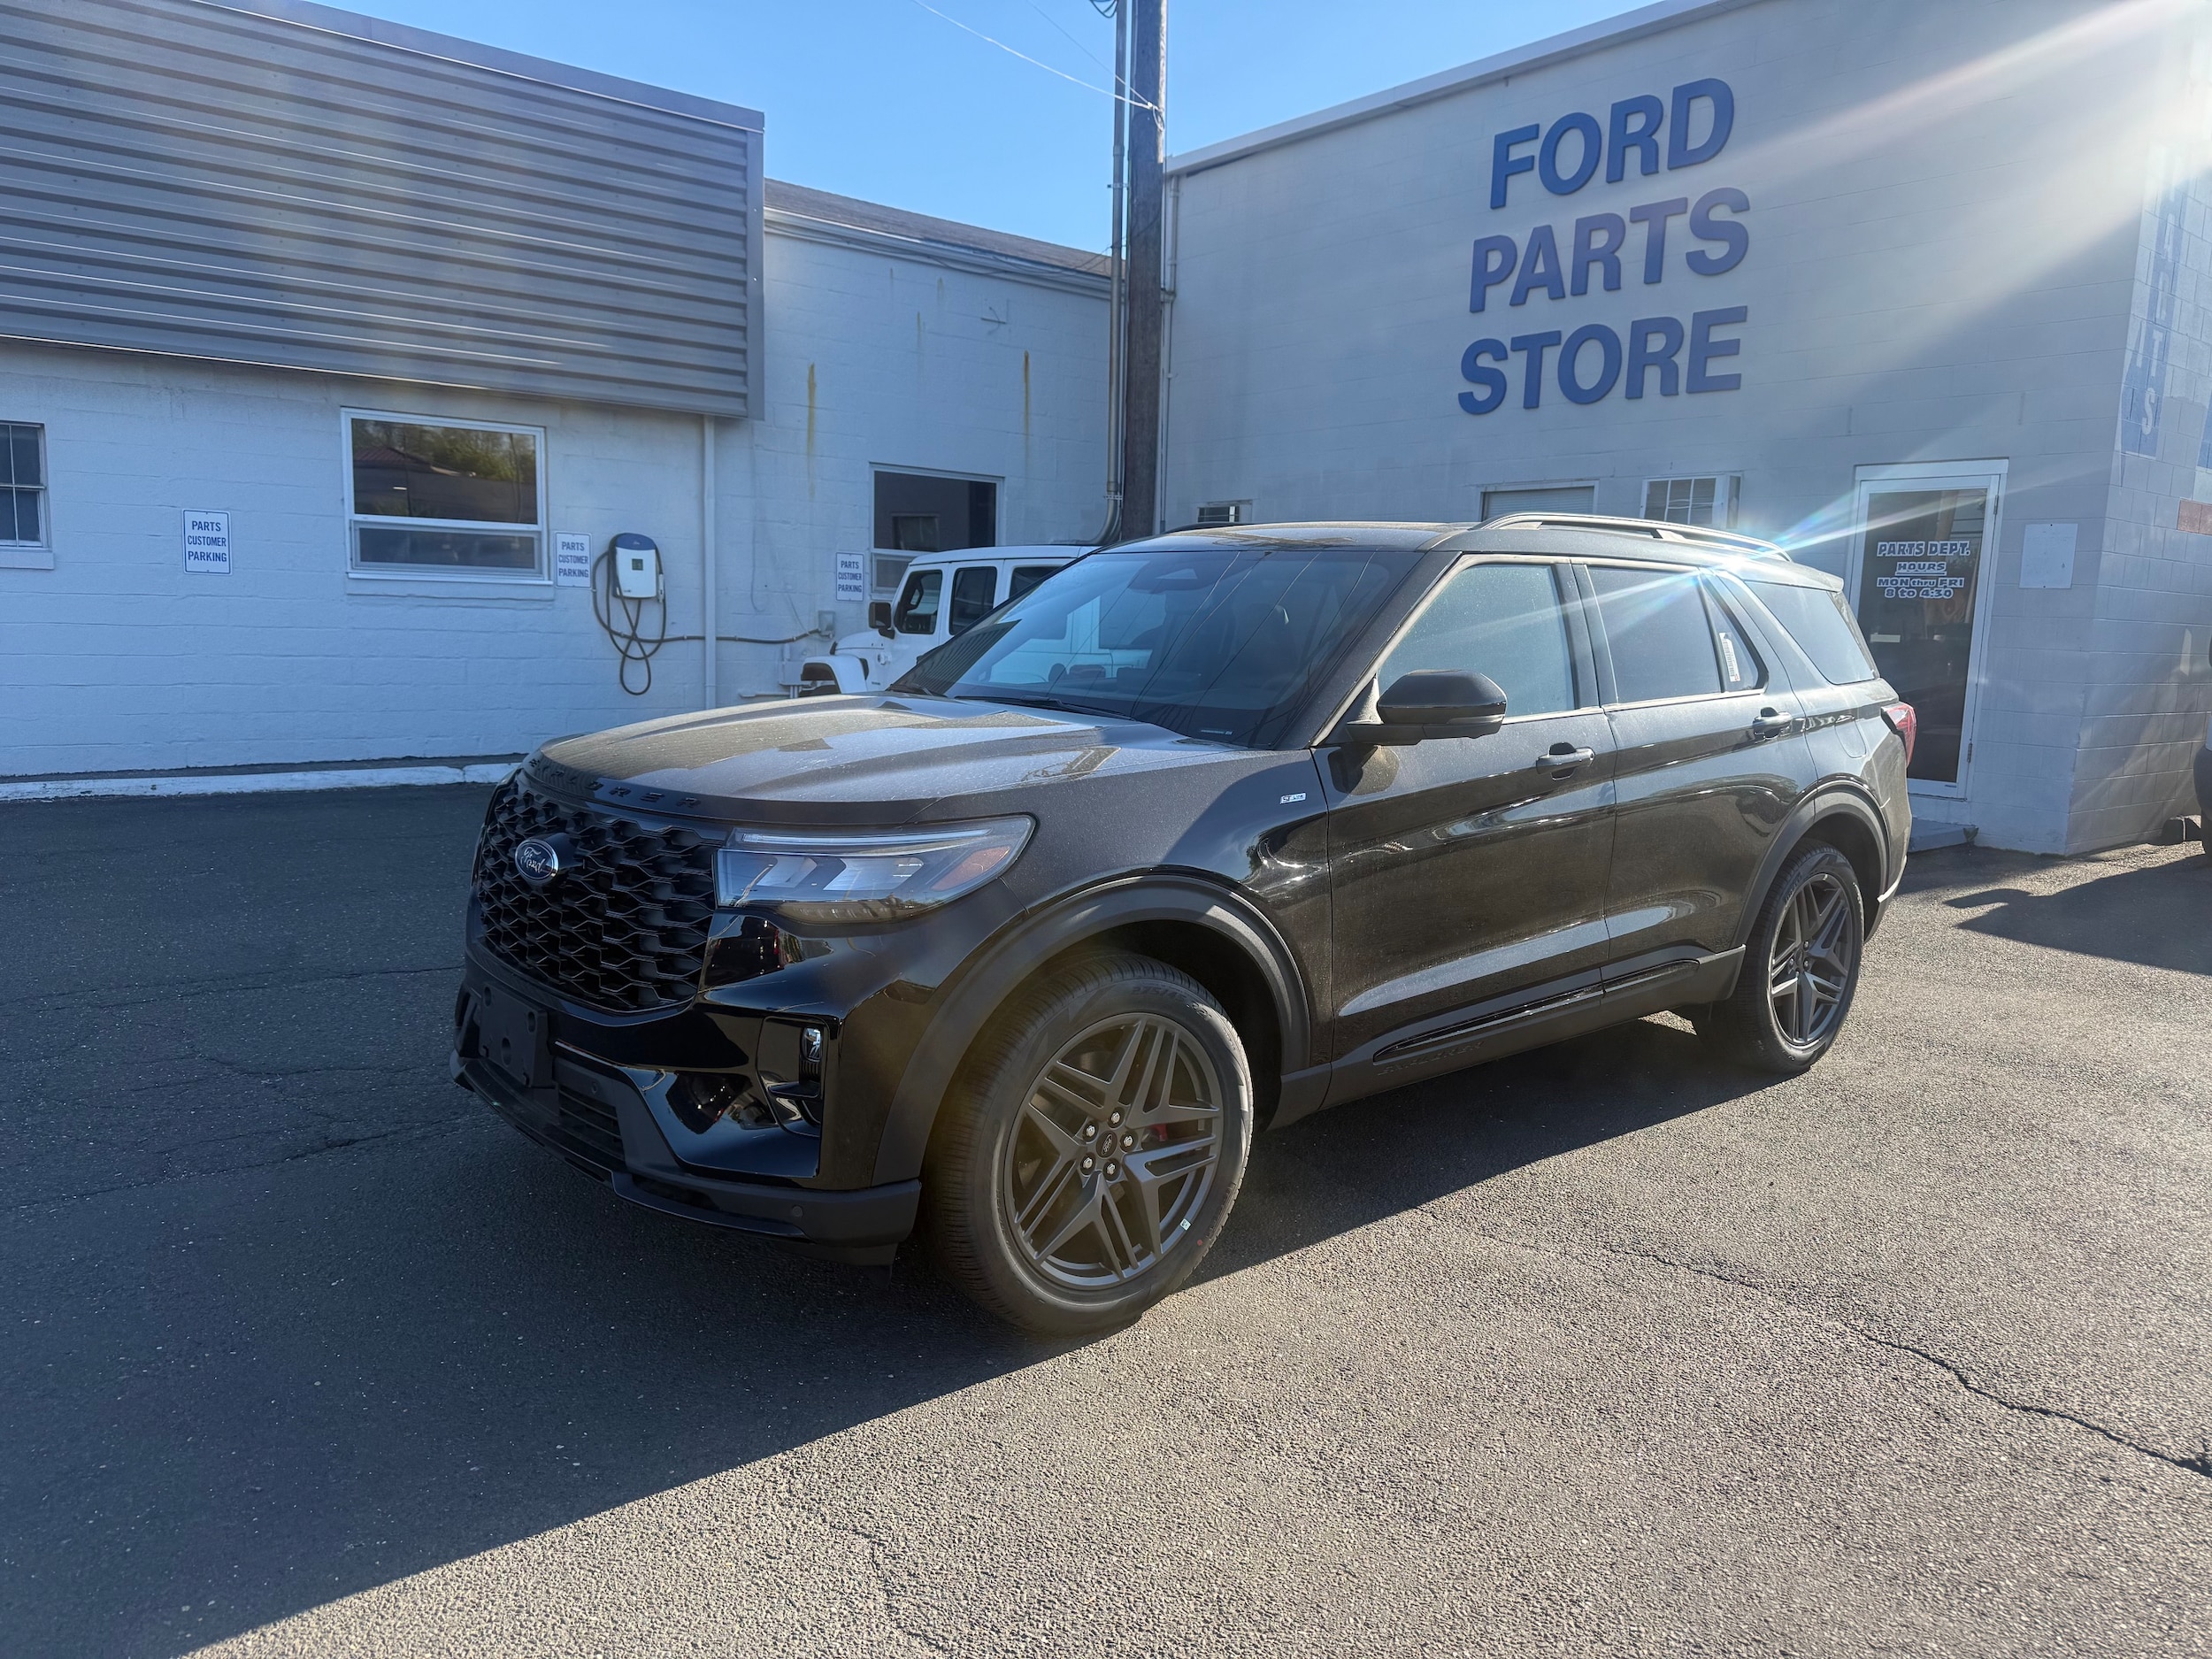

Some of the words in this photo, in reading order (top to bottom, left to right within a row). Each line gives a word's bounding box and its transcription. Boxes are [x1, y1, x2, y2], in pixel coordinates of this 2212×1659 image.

[1490, 78, 1735, 210] FORD
[1470, 187, 1750, 313] PARTS
[1457, 305, 1747, 416] STORE
[191, 520, 221, 532] PARTS
[187, 534, 227, 547] CUSTOMER
[561, 541, 585, 551] PARTS
[1877, 541, 1925, 557] PARTS
[1927, 541, 1970, 556] DEPT.
[188, 550, 227, 562] PARKING
[558, 554, 588, 565] CUSTOMER
[841, 560, 859, 570] PARTS
[1895, 561, 1947, 572] HOURS
[558, 567, 589, 578] PARKING
[838, 572, 862, 581] CUSTOMER
[1877, 577, 1910, 588] MON
[1910, 578, 1936, 588] thru
[1937, 577, 1964, 588] FRI
[838, 584, 863, 593] PARKING
[1885, 588, 1895, 597] 8
[1898, 587, 1917, 597] to
[1919, 588, 1954, 599] 4:30
